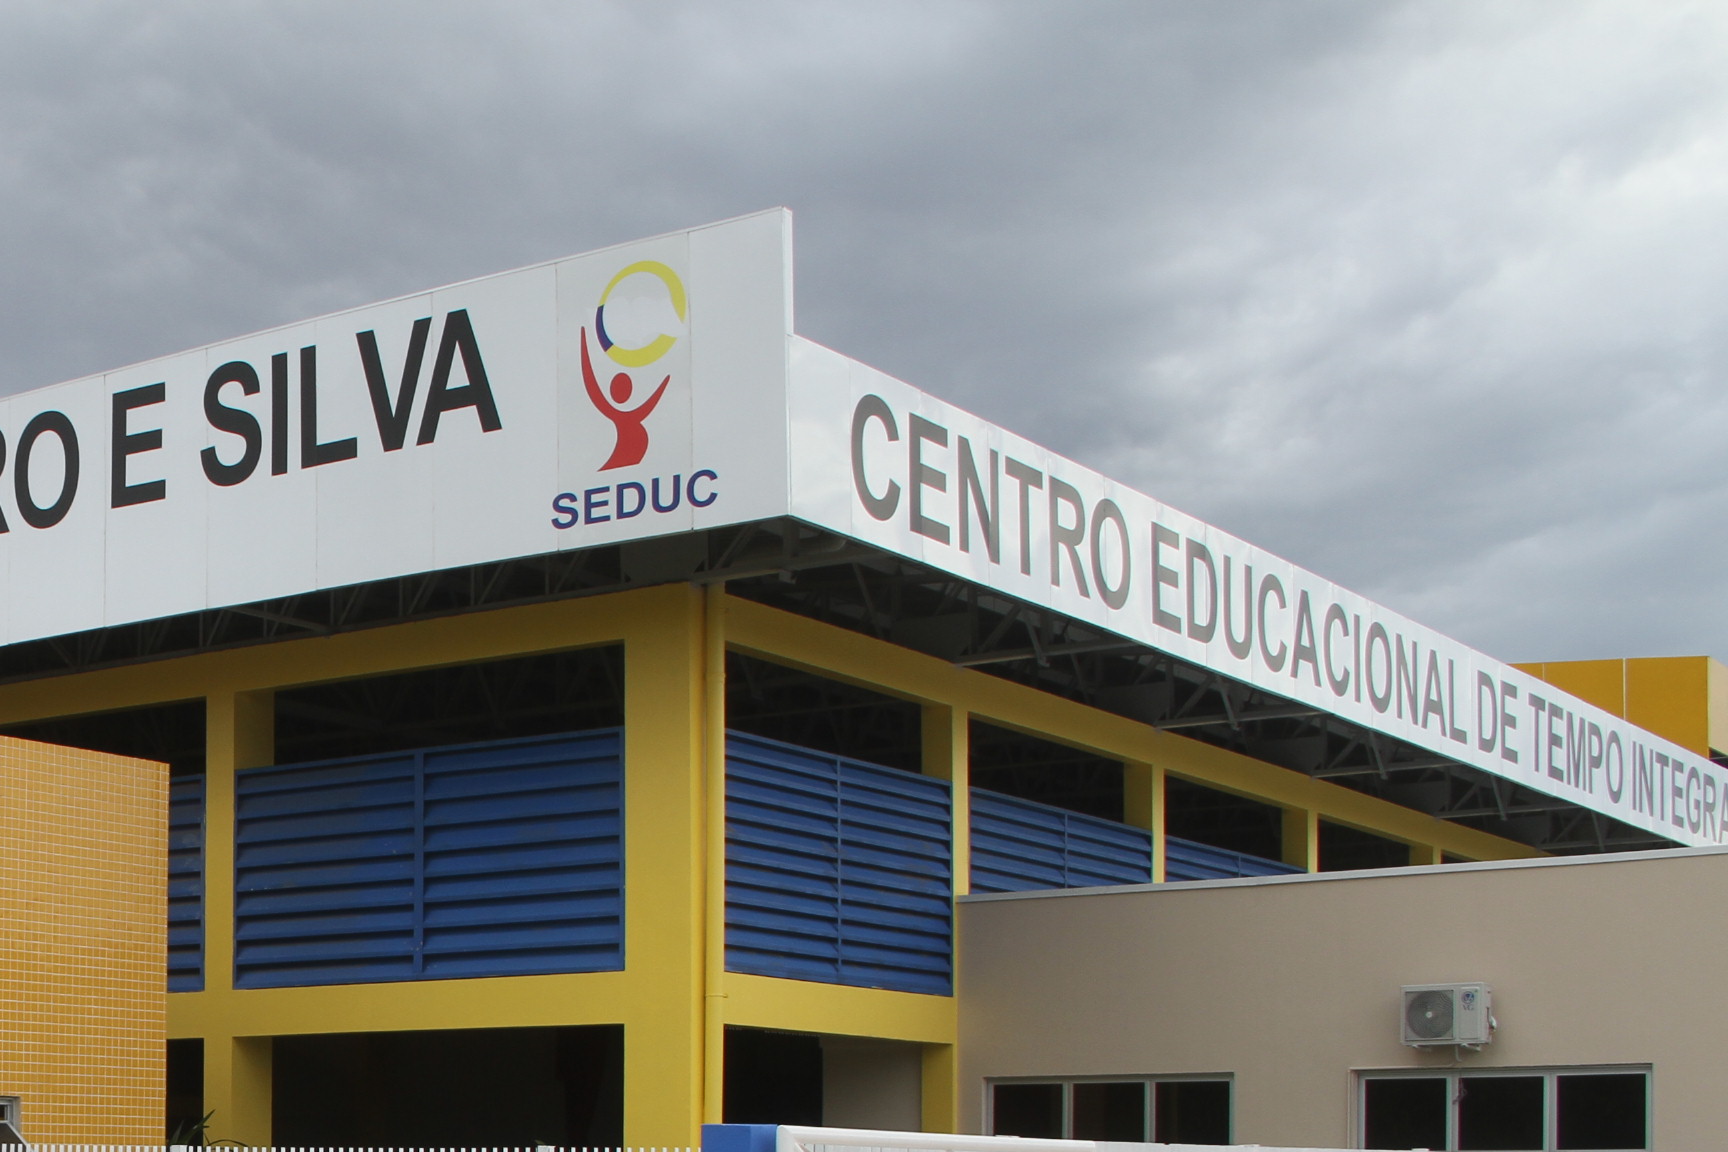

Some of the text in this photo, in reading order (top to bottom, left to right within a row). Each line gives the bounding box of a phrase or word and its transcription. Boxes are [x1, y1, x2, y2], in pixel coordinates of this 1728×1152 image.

[111, 381, 166, 509] E
[200, 308, 503, 487] SILVA
[550, 468, 720, 530] SEDUC
[850, 393, 1132, 611] CENTRO
[1150, 520, 1468, 745] EDUCACIONAL
[1476, 670, 1518, 764] DE
[1528, 692, 1624, 805] TEMPO
